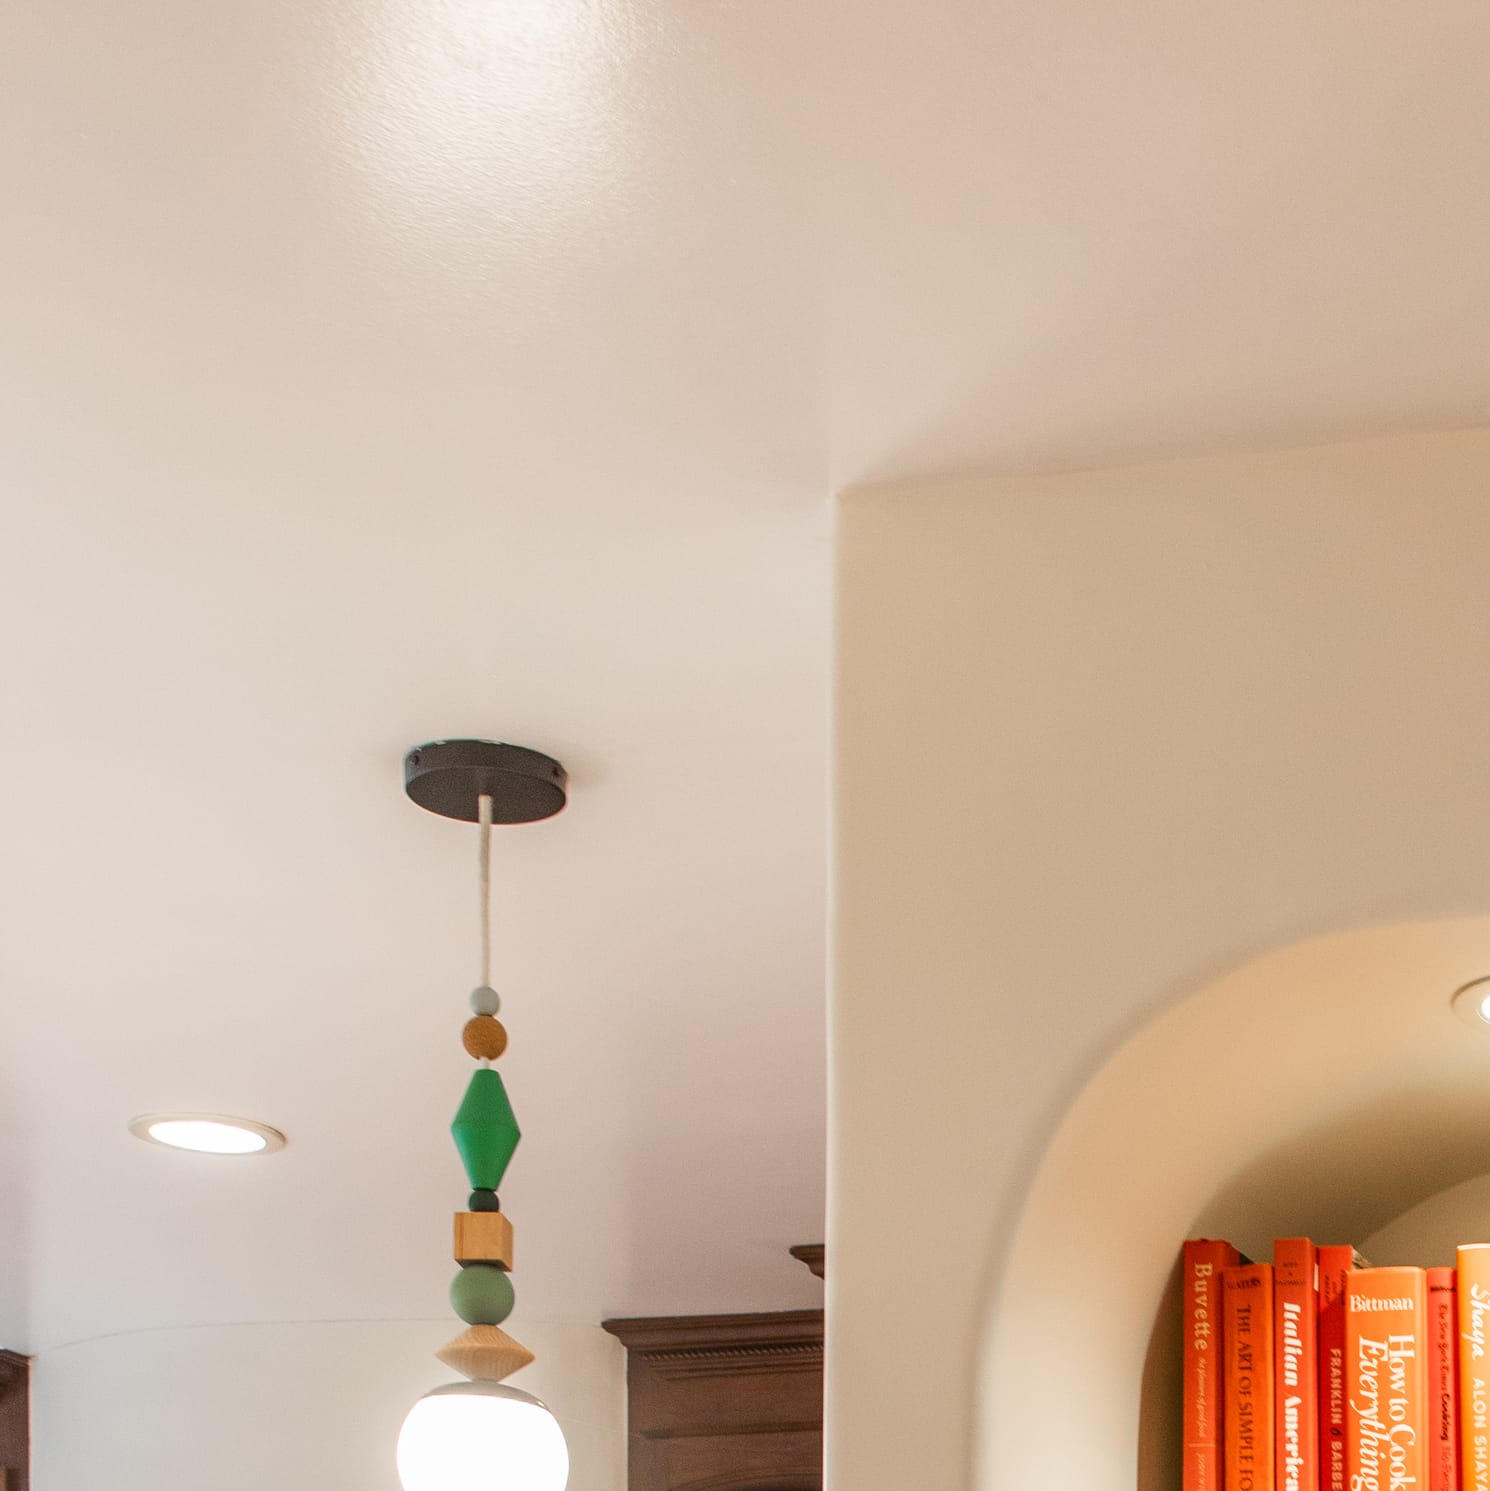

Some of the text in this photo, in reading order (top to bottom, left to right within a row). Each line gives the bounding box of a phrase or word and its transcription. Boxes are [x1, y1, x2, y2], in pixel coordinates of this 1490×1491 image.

[1193, 1262, 1213, 1351] Buvette
[1237, 1305, 1252, 1336] THE
[1350, 1295, 1414, 1313] Bittman
[1237, 1341, 1253, 1373] ART
[1283, 1302, 1302, 1387] Italian
[1238, 1377, 1252, 1397] OF
[1330, 1348, 1342, 1424] FRANKLIN
[1388, 1334, 1417, 1491] How to Cook
[1472, 1377, 1487, 1428] ALON
[1238, 1401, 1254, 1465] SIMPLE
